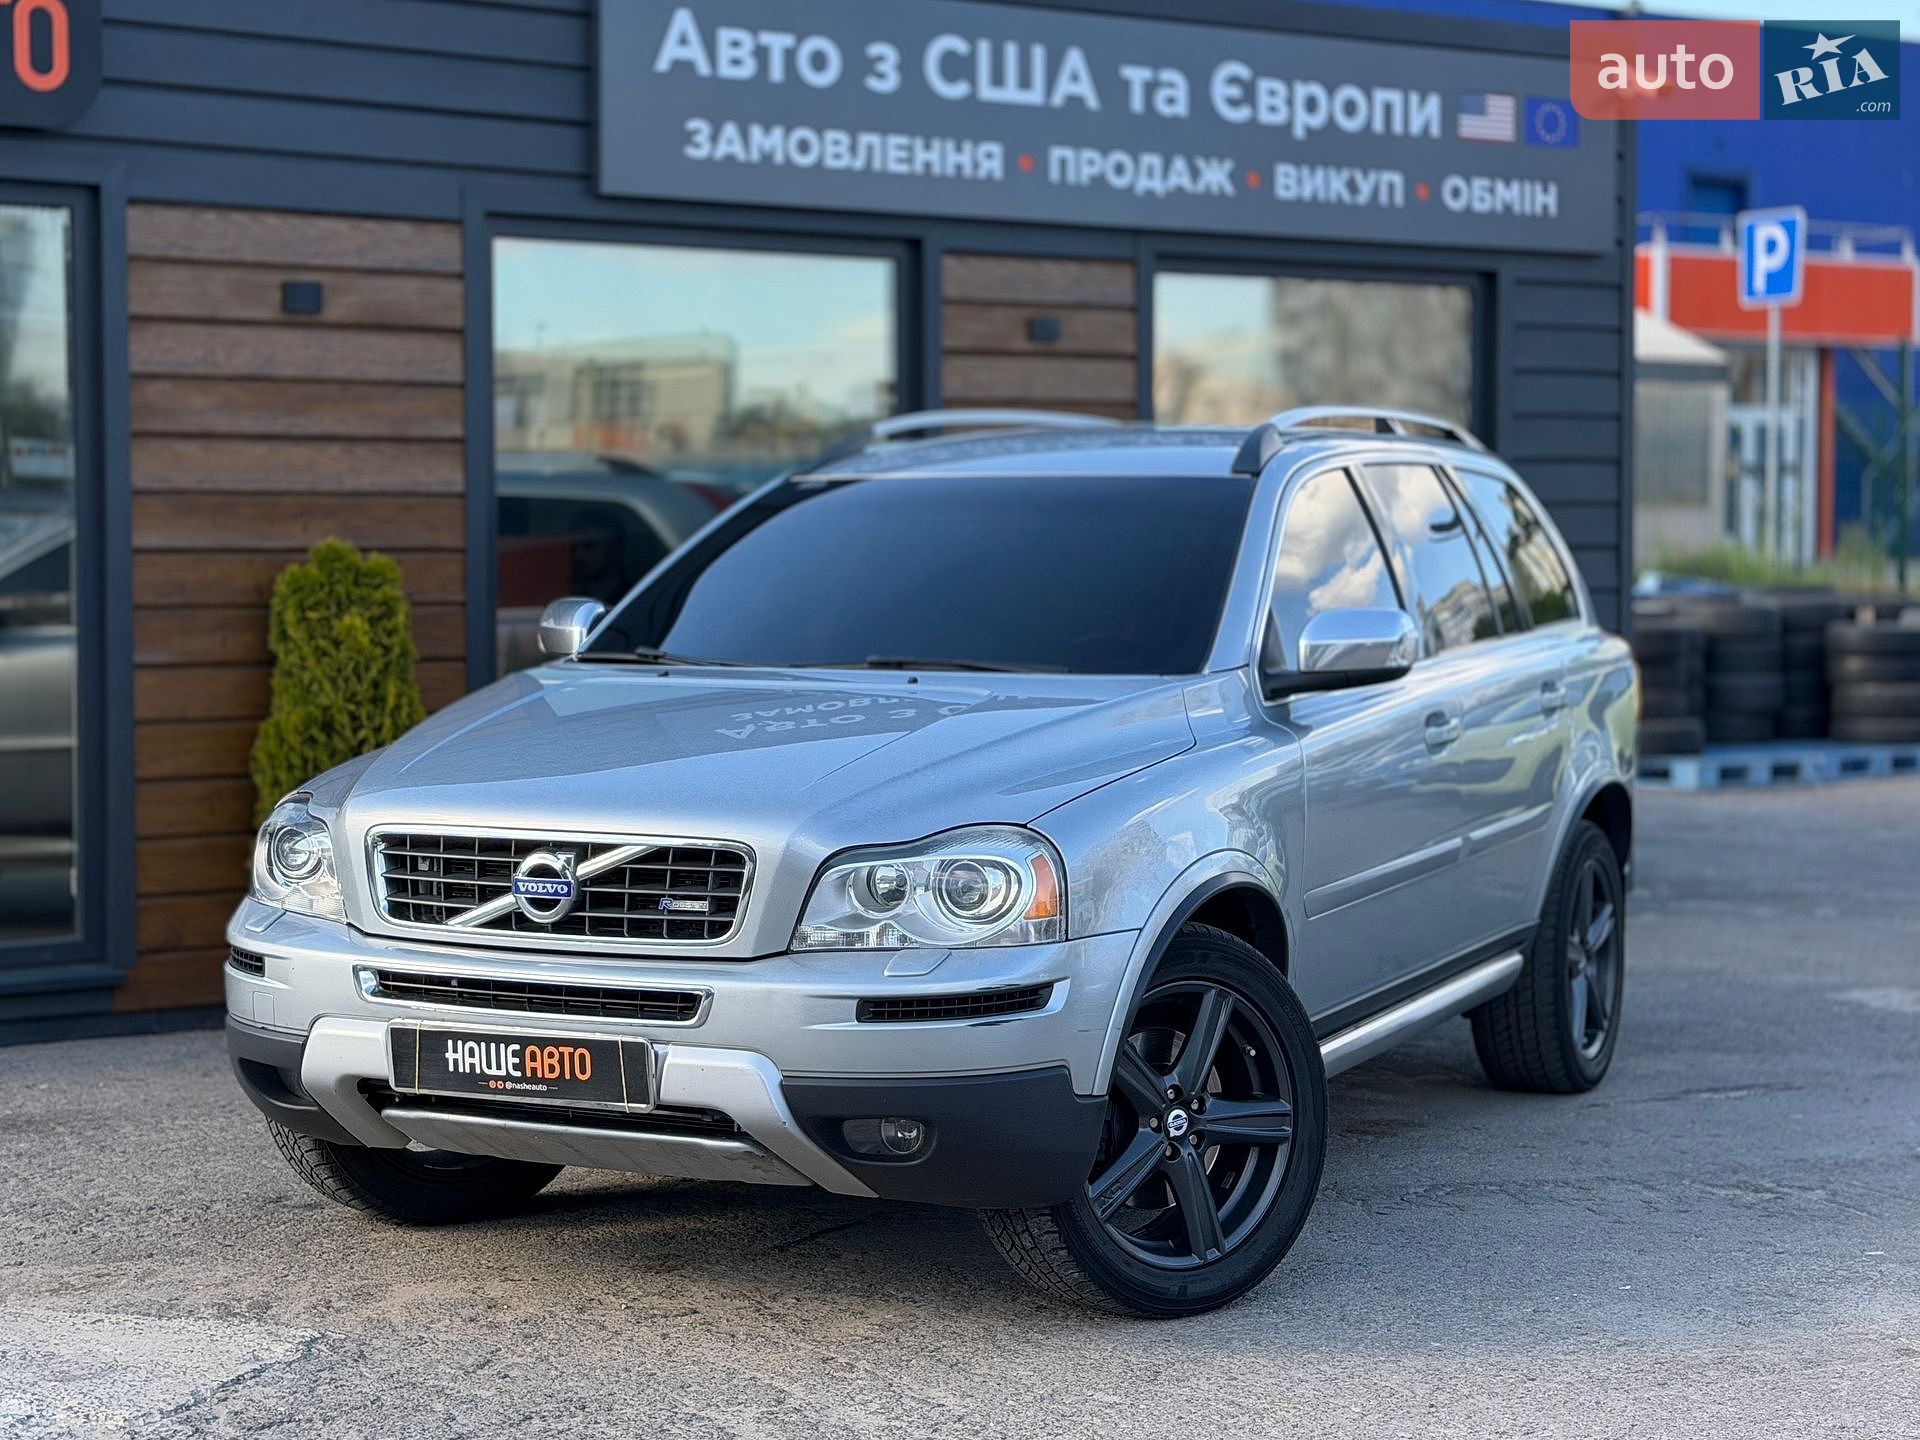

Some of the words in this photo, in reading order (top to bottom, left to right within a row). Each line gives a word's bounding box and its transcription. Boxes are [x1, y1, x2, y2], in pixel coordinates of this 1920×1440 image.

[653, 7, 842, 88] Авто
[864, 42, 901, 94] з
[923, 34, 1100, 110] США
[1119, 64, 1191, 119] та
[1209, 60, 1442, 140] Європи
[683, 118, 1005, 181] ЗАМОВЛЕННЯ
[1048, 147, 1236, 197] ПРОДАЖ
[1273, 163, 1405, 207] ВИКУП
[1441, 176, 1558, 218] ОБМІН
[1753, 222, 1791, 296] P
[517, 881, 569, 894] VOLVO
